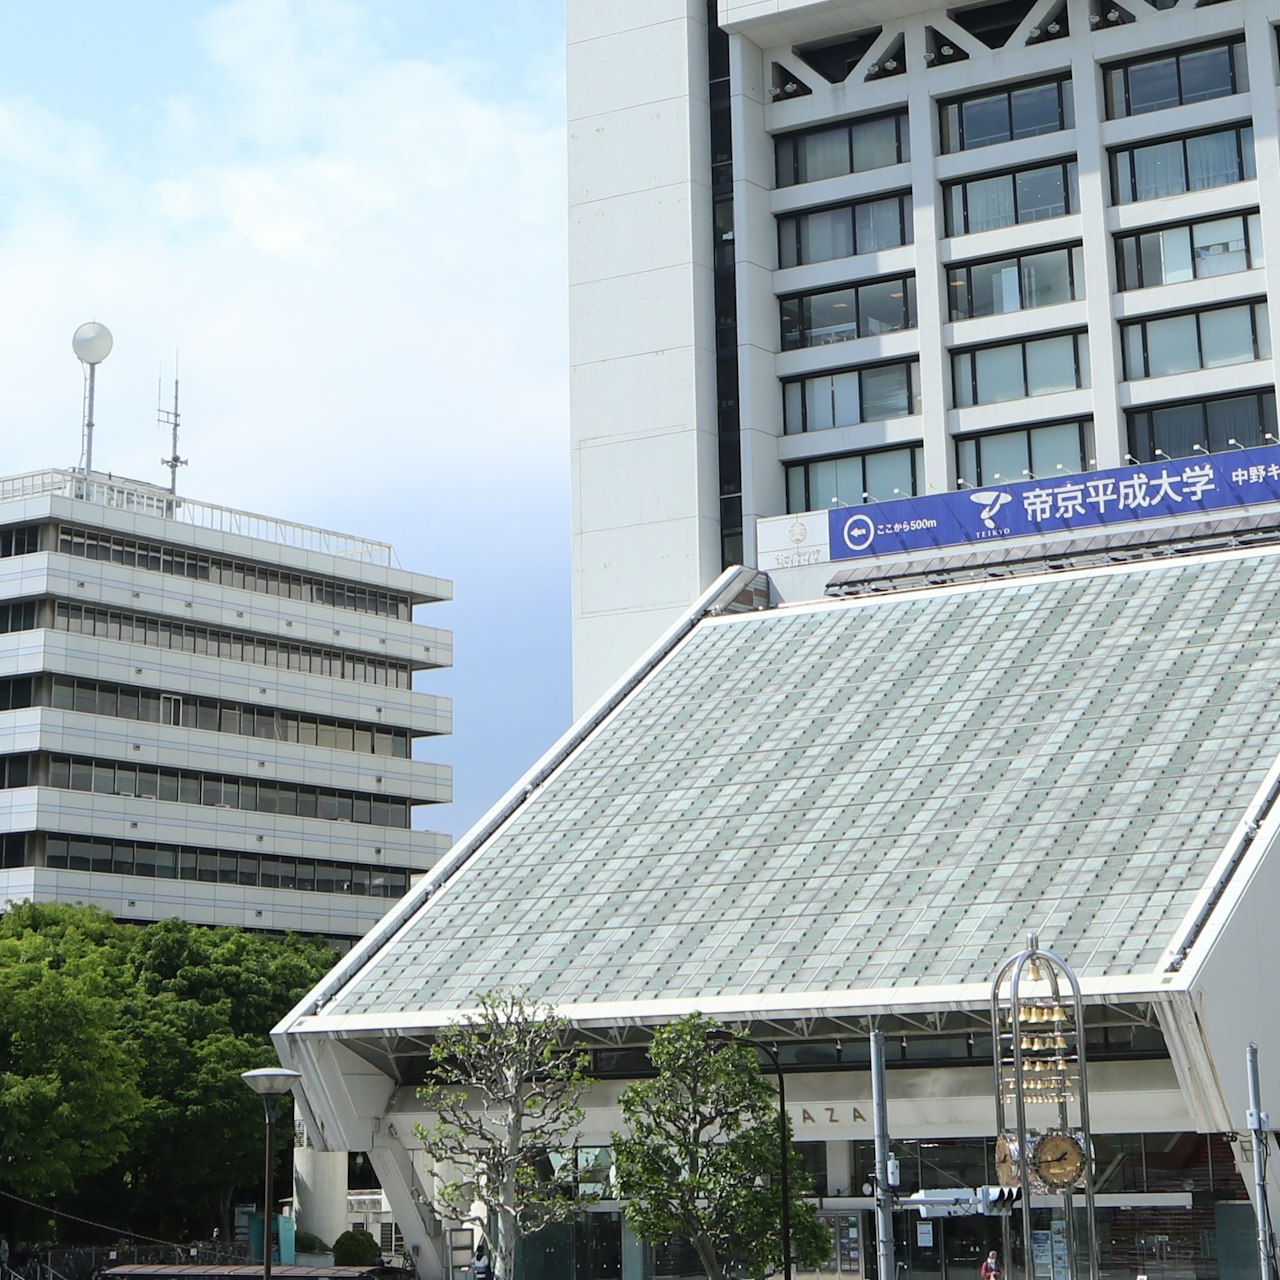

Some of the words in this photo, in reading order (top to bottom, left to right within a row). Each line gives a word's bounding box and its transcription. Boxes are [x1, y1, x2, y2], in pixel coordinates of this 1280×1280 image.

[1022, 463, 1216, 522] 帝京平成大学
[876, 518, 937, 535] ここから500m
[975, 527, 1011, 539] TEIKYO
